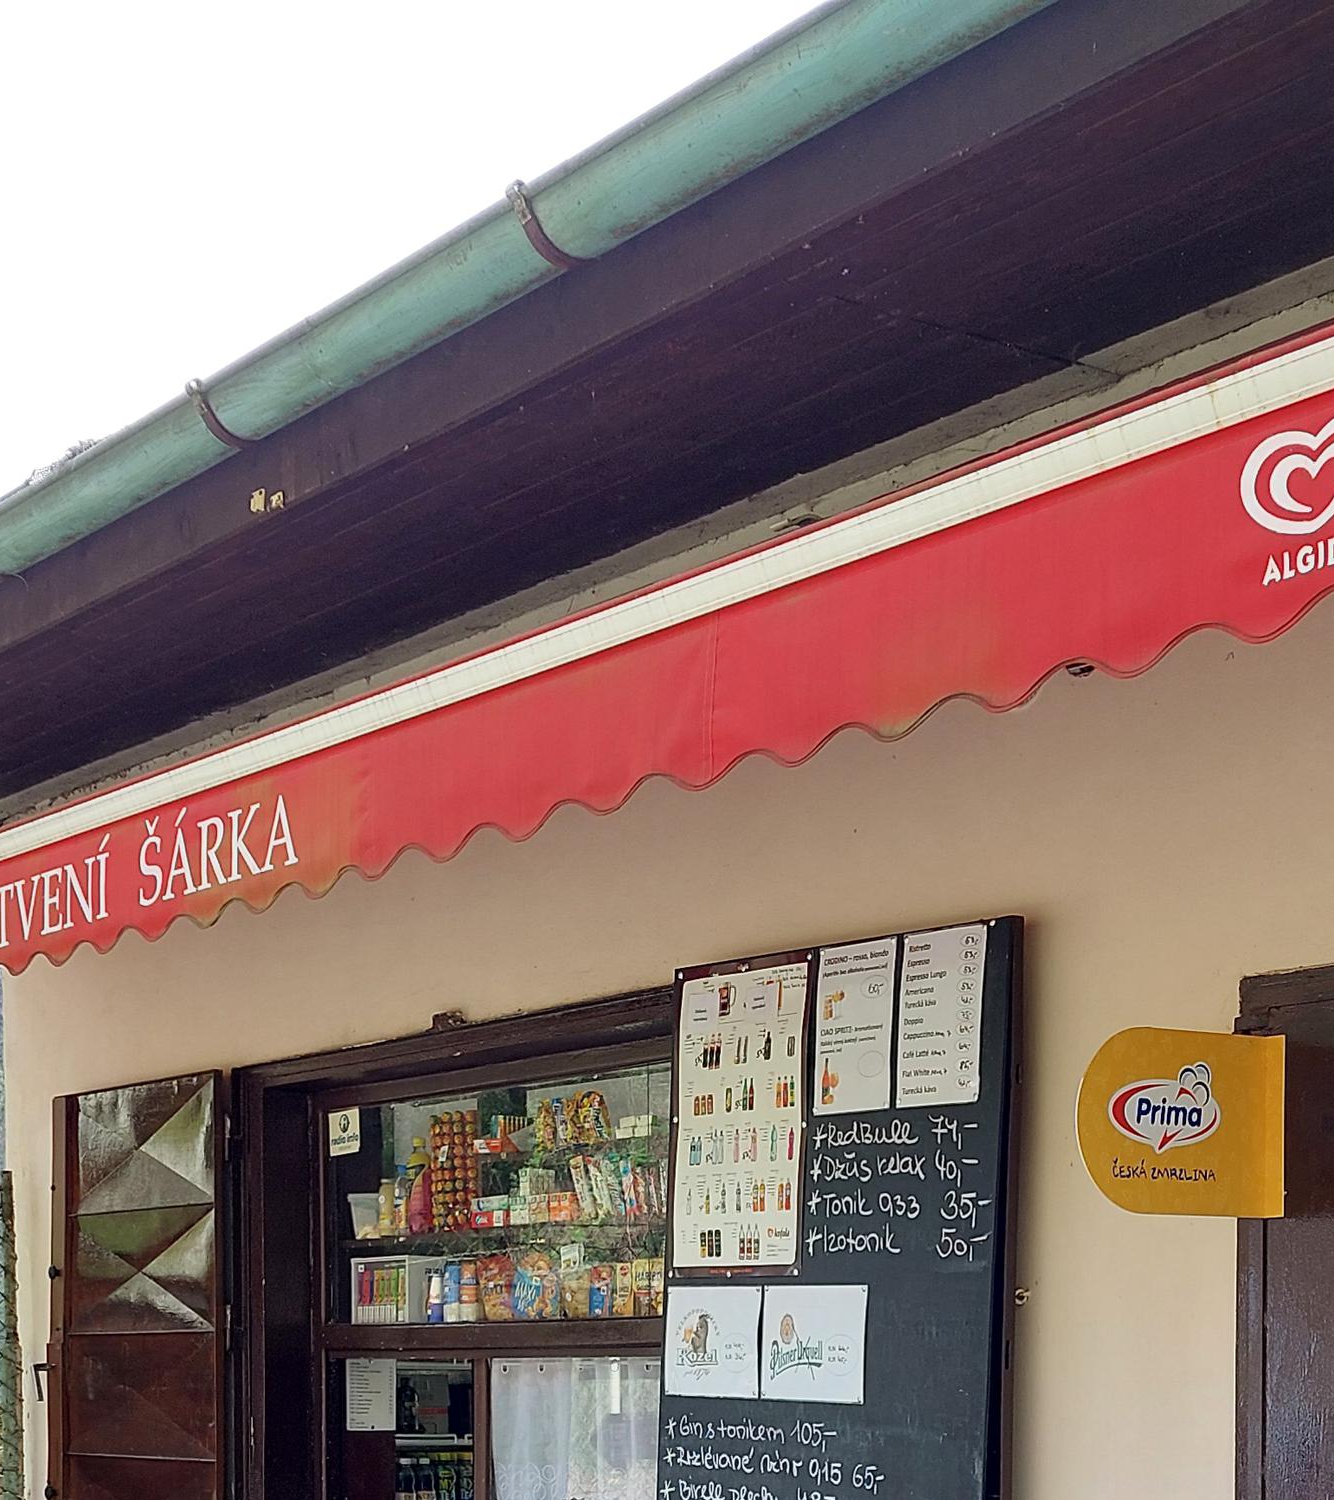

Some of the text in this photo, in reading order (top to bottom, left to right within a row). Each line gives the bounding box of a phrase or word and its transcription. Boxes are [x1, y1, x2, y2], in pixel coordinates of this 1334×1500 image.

[137, 794, 299, 907] ŠÁRKA
[1136, 1097, 1203, 1128] Prima
[1112, 1157, 1217, 1182] ČESKÁ ZMRZLINA
[823, 1188, 874, 1218] Tonik
[823, 1222, 902, 1254] Izotonik
[676, 1348, 718, 1367] Kozel
[769, 1340, 797, 1381] Pilsner
